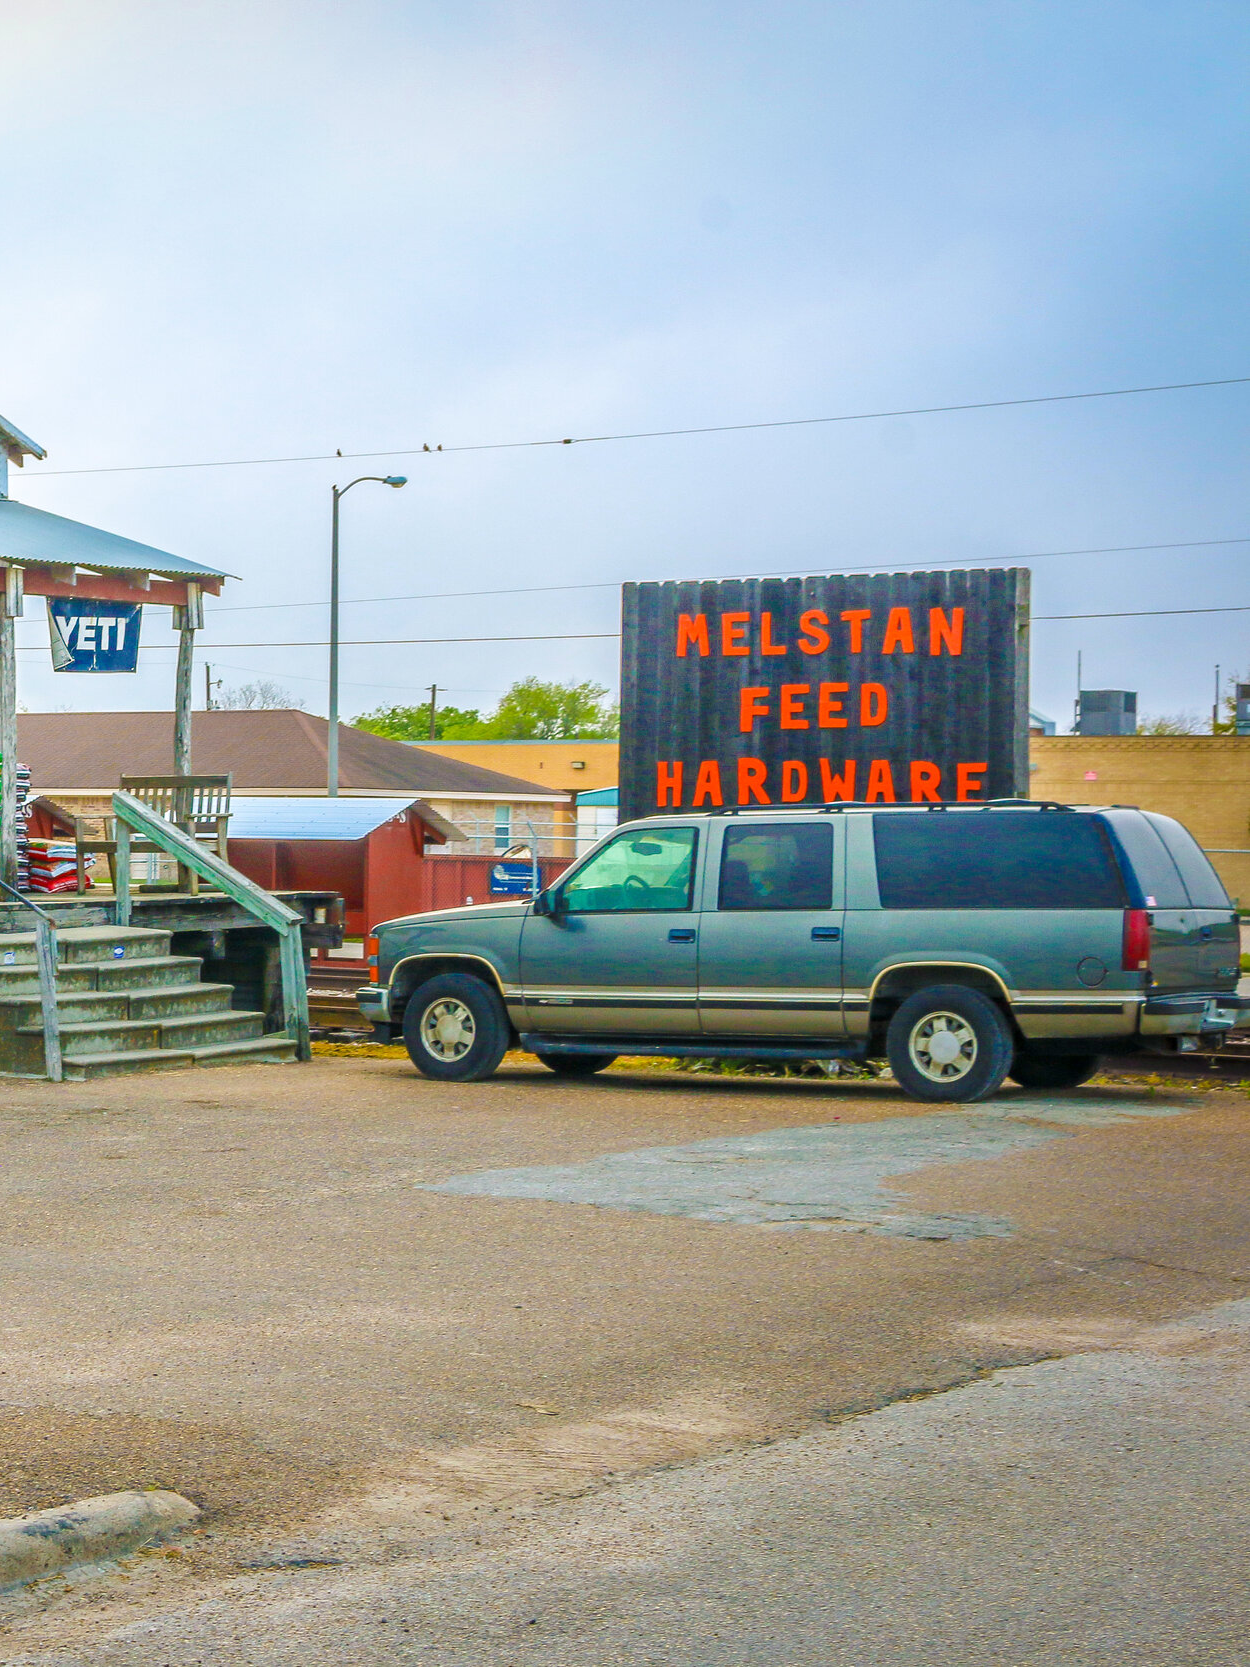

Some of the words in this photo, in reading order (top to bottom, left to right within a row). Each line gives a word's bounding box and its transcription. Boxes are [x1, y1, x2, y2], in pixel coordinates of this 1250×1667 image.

[55, 616, 126, 651] YETI
[676, 607, 965, 657] MELSTAN
[739, 682, 889, 733] FEED
[656, 757, 988, 808] HARDWARE
